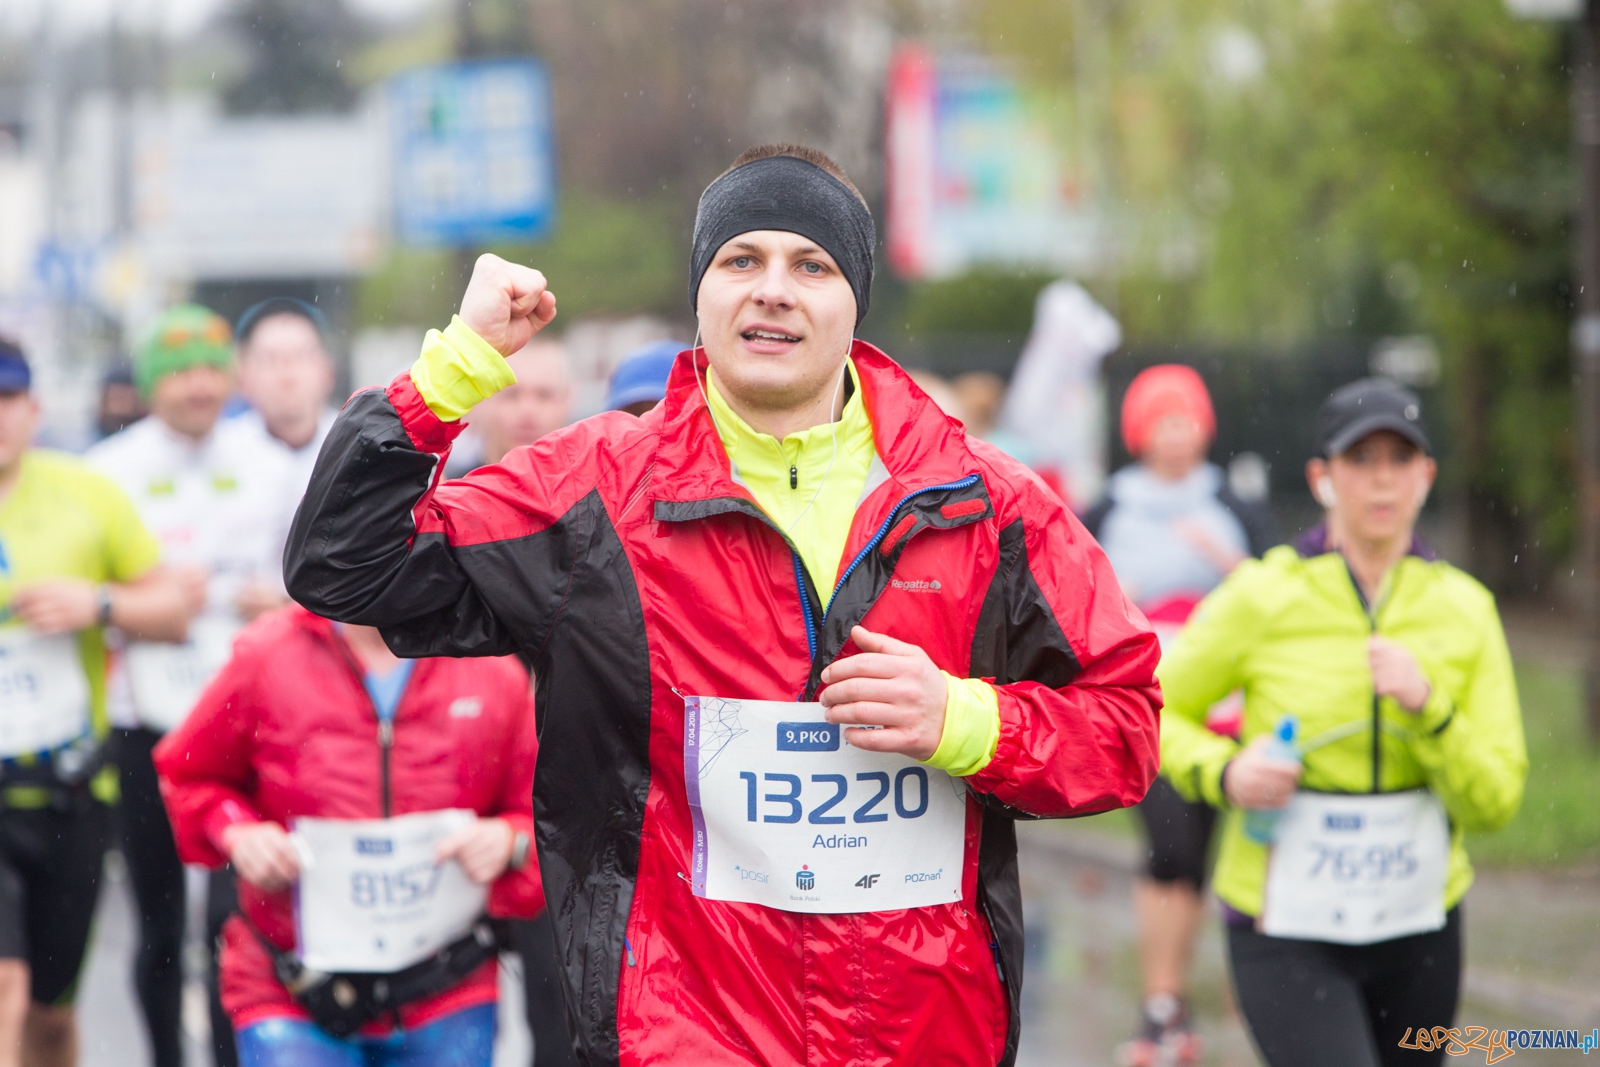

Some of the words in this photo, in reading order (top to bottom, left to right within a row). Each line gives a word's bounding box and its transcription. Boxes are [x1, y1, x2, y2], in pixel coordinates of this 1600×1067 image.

[891, 579, 929, 590] Regatta
[785, 731, 797, 744] 9.
[799, 731, 831, 744] PKO
[739, 766, 929, 825] 13220
[812, 834, 867, 848] Adrian
[1307, 842, 1418, 882] 7695
[854, 873, 881, 889] 4F
